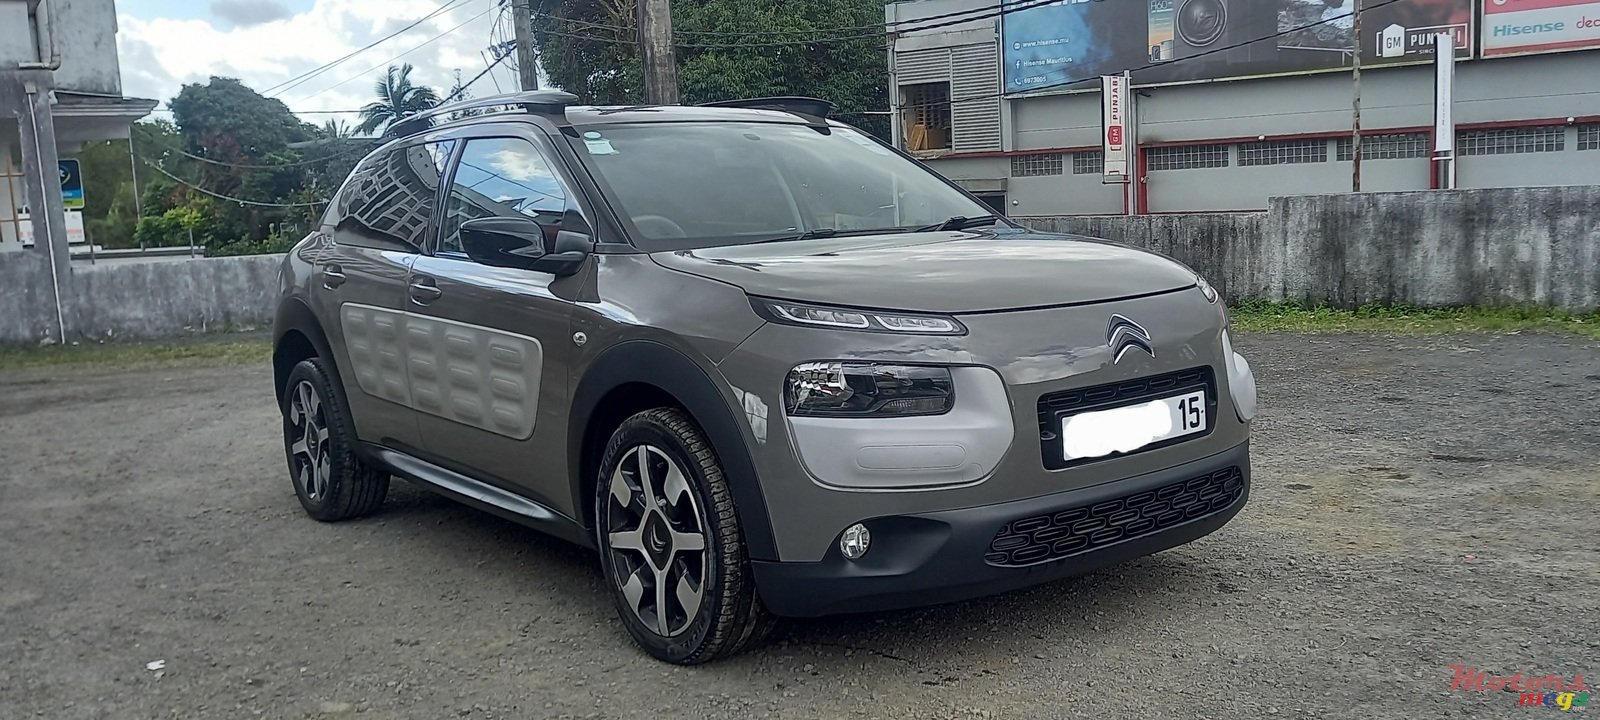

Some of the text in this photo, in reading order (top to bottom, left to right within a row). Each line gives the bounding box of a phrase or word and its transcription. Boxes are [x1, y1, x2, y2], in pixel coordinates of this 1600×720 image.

[1493, 21, 1565, 37] Hisense
[1022, 37, 1070, 48] www.hisense.mu
[1386, 37, 1401, 49] GM
[1023, 56, 1073, 67] Hisense Mauritius
[1112, 128, 1119, 142] GM
[1178, 396, 1200, 431] 15
